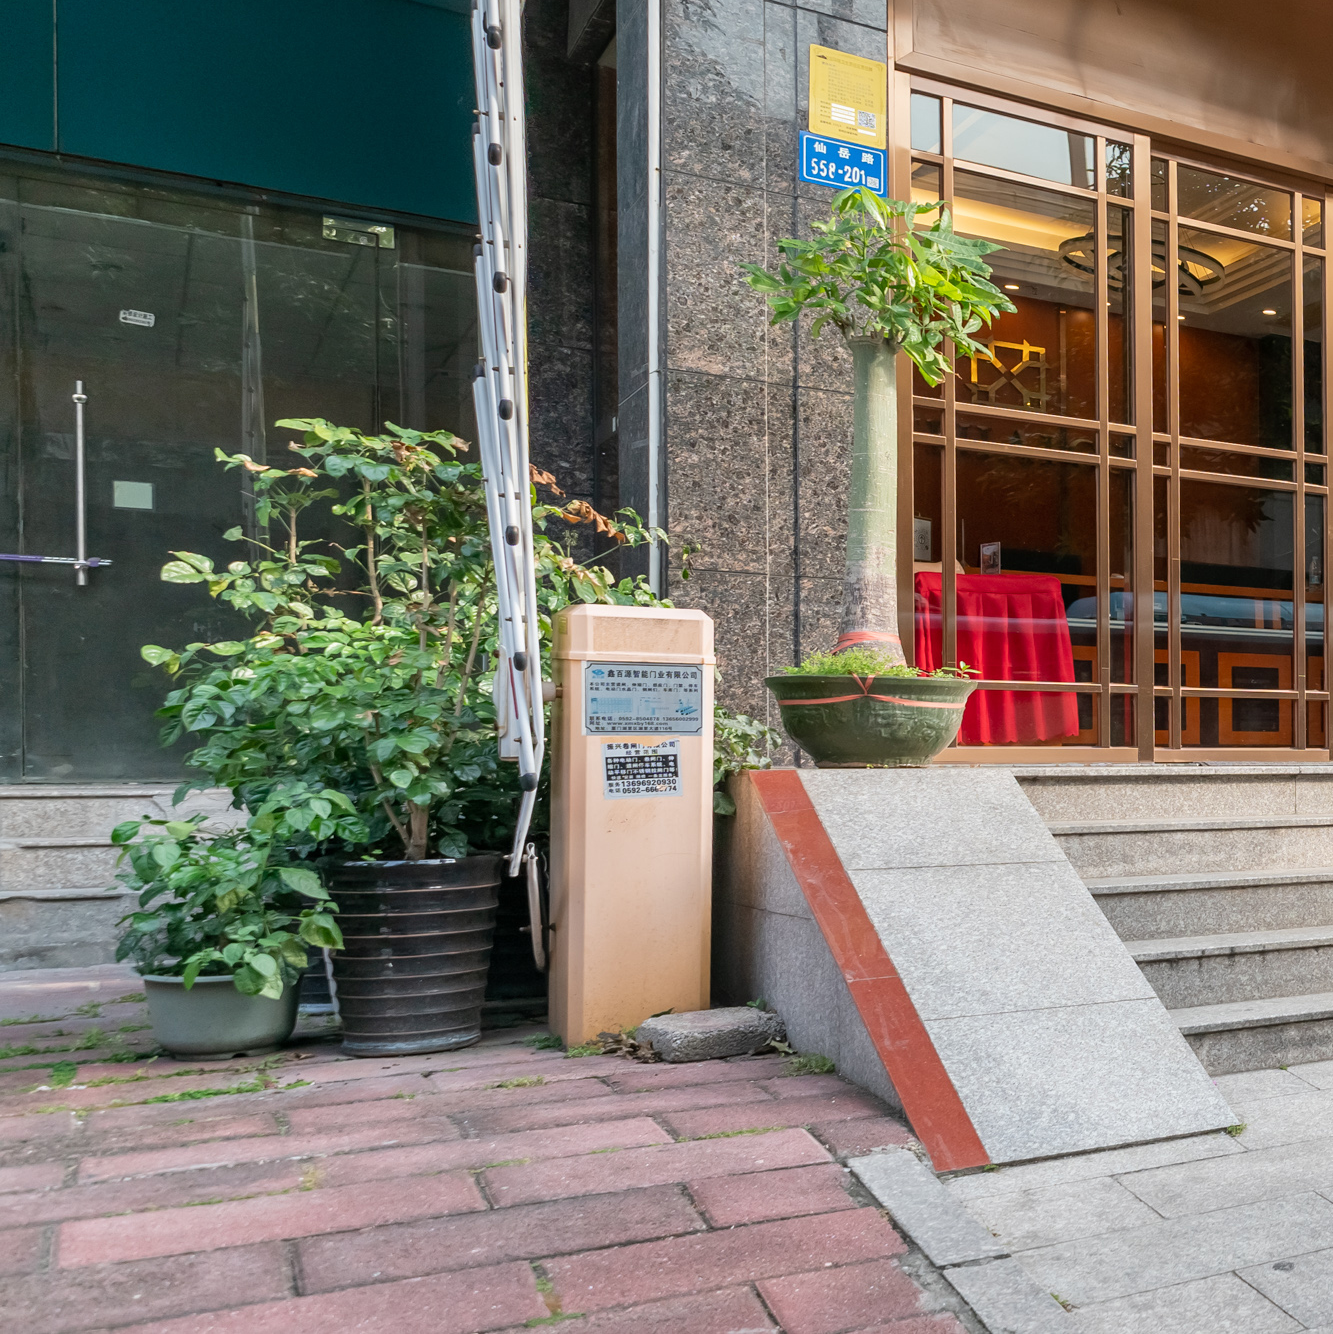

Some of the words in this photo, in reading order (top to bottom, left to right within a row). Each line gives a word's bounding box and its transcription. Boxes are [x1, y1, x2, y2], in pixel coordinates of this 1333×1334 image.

[814, 141, 875, 165] 仙岳路
[607, 669, 698, 680] 鑫百源智能门业有限公司
